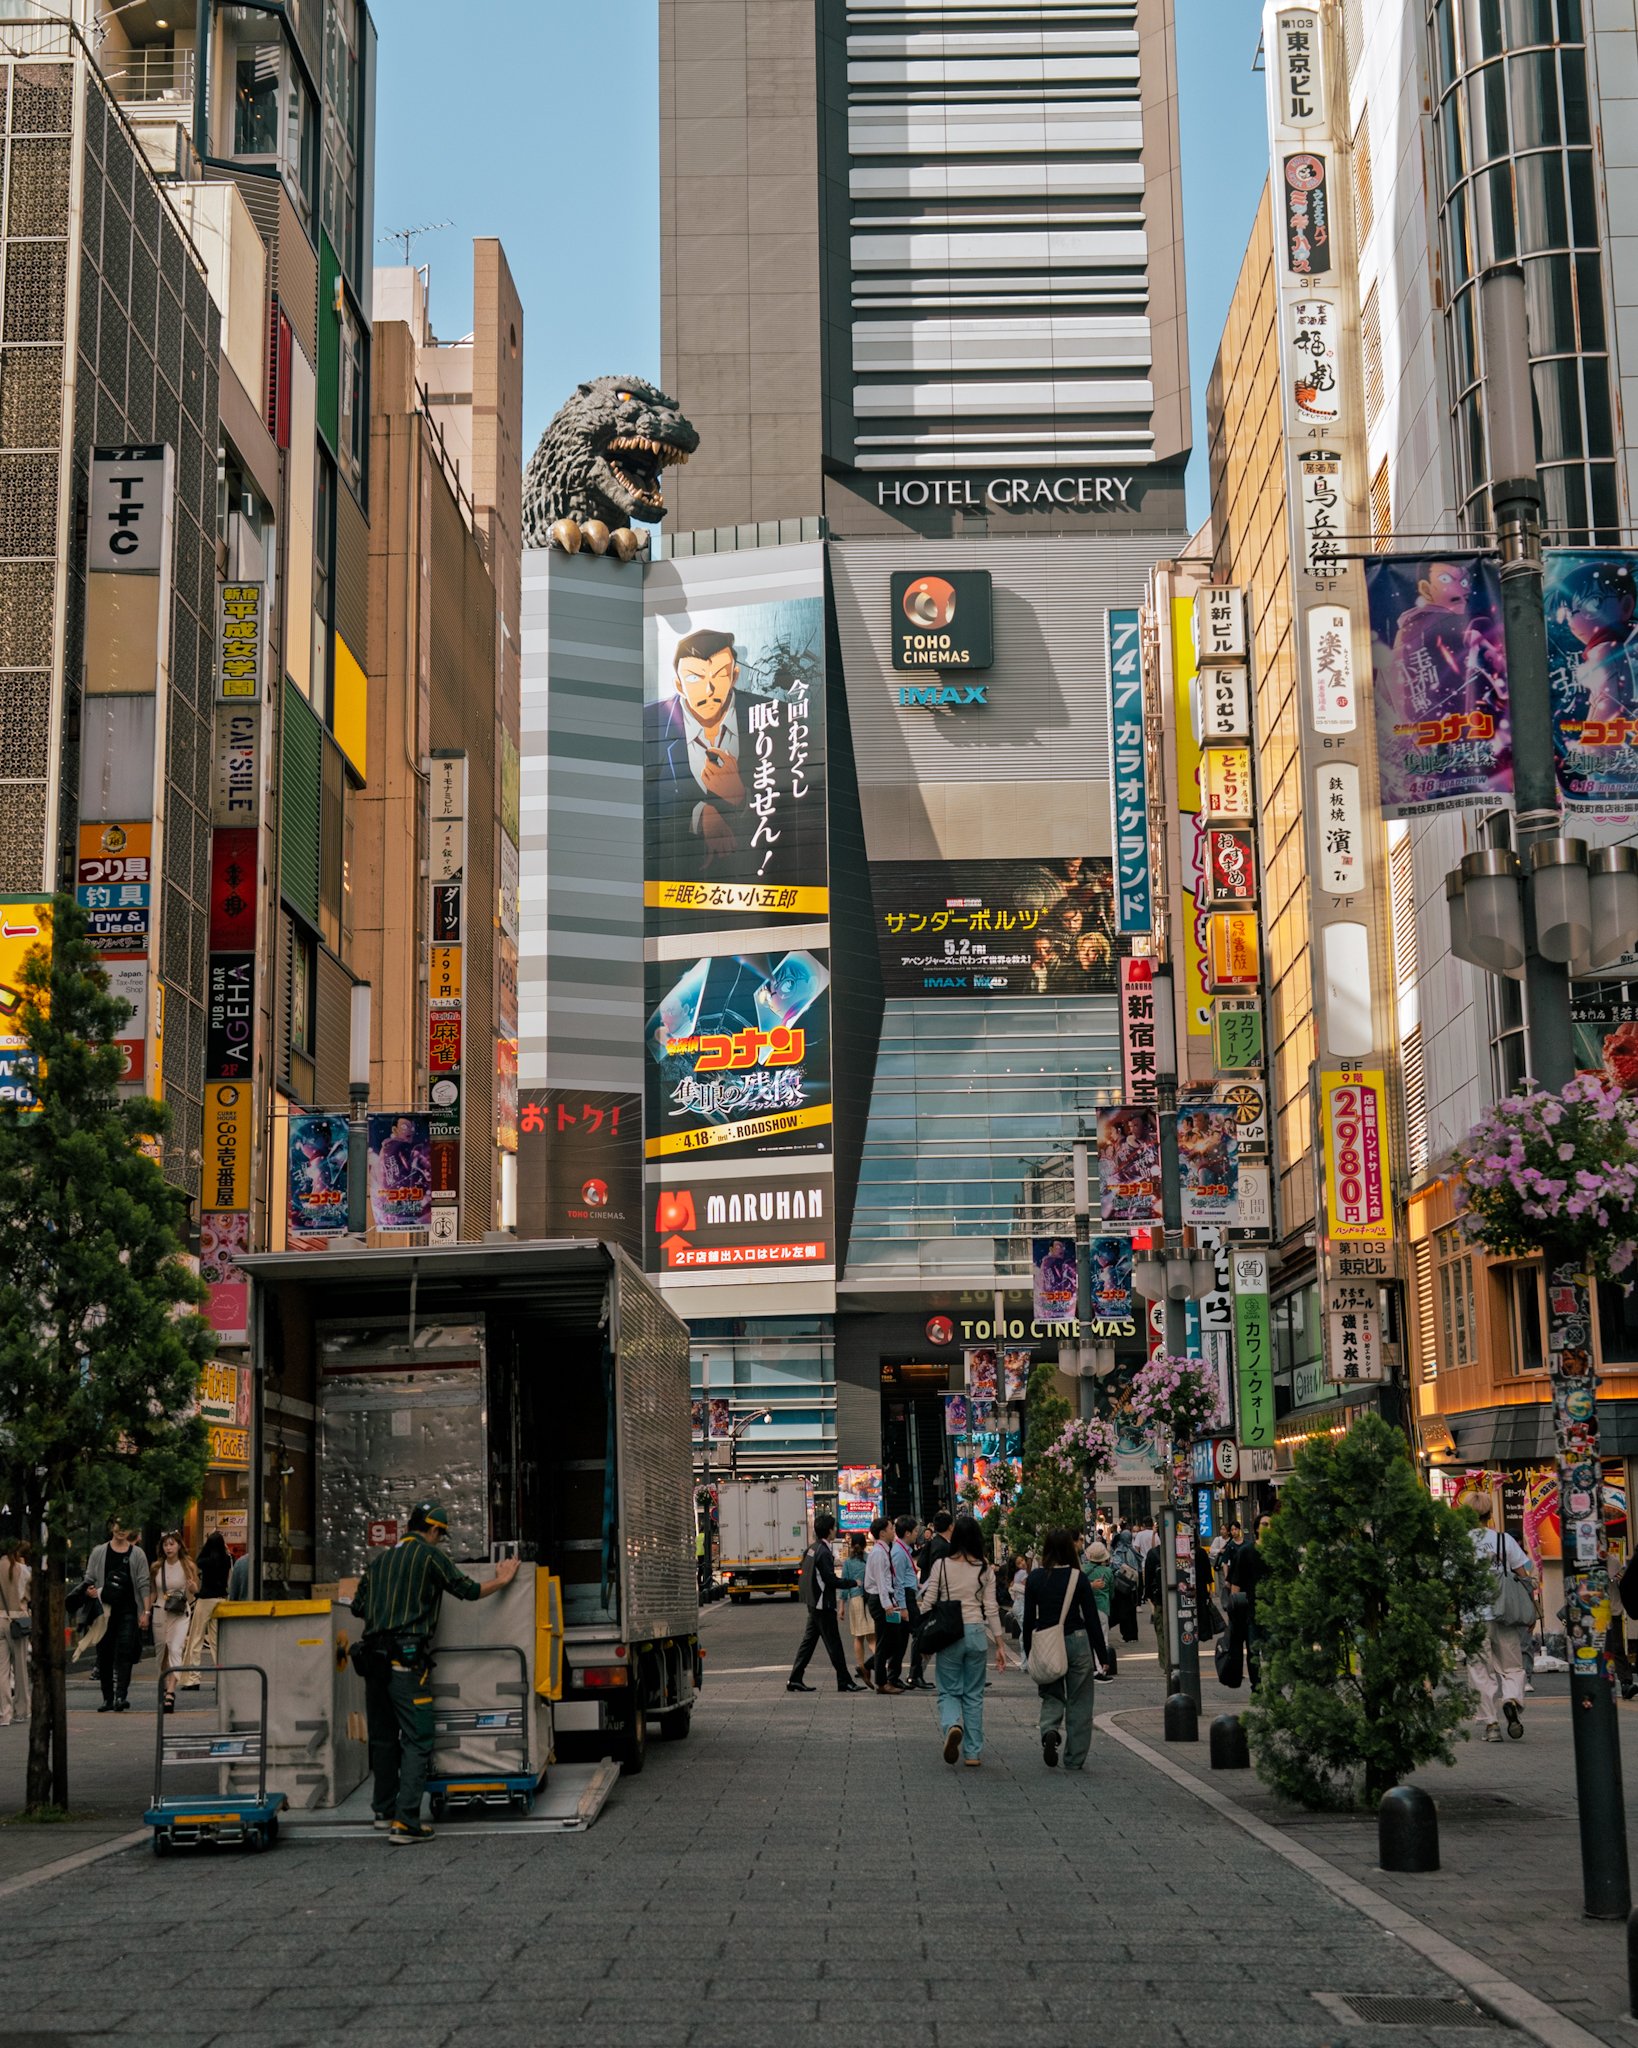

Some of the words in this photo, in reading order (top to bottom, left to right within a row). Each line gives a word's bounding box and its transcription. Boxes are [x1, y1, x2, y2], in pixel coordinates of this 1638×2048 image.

[1281, 19, 1313, 28] 第103
[1286, 31, 1314, 118] 東京ビル
[1299, 278, 1321, 288] 3F
[1308, 428, 1329, 438] 4F
[112, 450, 145, 461] 7F
[1310, 451, 1331, 460] 5F
[878, 480, 980, 505] HOTEL
[987, 477, 1134, 503] GRACERY
[108, 477, 145, 555] TFC
[223, 587, 259, 601] 新宿
[1315, 581, 1337, 591] 5F
[1210, 590, 1233, 653] 川新ビル
[223, 602, 258, 697] 平成女学園
[903, 634, 951, 649] TOHO
[903, 650, 970, 664] CINEMAS
[1112, 623, 1140, 708] 747
[1317, 631, 1346, 688] 楽天屋
[899, 686, 988, 705] IMAX
[1215, 669, 1235, 732] にいむら
[787, 679, 809, 798] 今回わたくし
[1323, 738, 1345, 748] 6F
[228, 717, 254, 811] CAPSULE
[443, 762, 453, 814] 第1モナミビル
[748, 698, 781, 876] 眠りません！
[1221, 755, 1239, 812] ととりこ
[1409, 780, 1435, 793] 4.18
[1438, 776, 1488, 788] ROADSHOW
[1329, 777, 1346, 822] 鉄板焼
[1397, 796, 1503, 817] 歌舞伎町商店街振興組合
[1115, 721, 1147, 920] カラオケランド
[1326, 828, 1351, 854] 濱
[1218, 833, 1245, 886] おすすめ
[80, 858, 149, 882] つり具
[86, 885, 144, 907] 釣具
[664, 884, 799, 909] #眠らない小五郎
[1216, 887, 1228, 898] 7F
[1332, 897, 1354, 908] 7F
[127, 911, 141, 921] &
[443, 886, 459, 930] ダーツ
[96, 921, 145, 934] Used
[944, 938, 970, 956] 5.2
[971, 945, 987, 955] FRI
[116, 978, 143, 987] Tax-free
[118, 970, 144, 979] Japan.
[213, 967, 225, 991] BAR
[440, 948, 451, 997] 299円
[923, 976, 968, 988] IMAX
[125, 986, 144, 995] Shop
[1221, 1000, 1256, 1010] 質・買取
[212, 1004, 225, 1029] PUB
[430, 1022, 460, 1065] 麻雀
[1224, 1019, 1239, 1066] クォーク
[221, 1064, 239, 1076] 2F
[1250, 1059, 1261, 1067] 5F
[1340, 1061, 1363, 1071] 8F
[1341, 1072, 1363, 1083] 9階
[668, 1070, 811, 1116] 隻眼の残像
[520, 1102, 620, 1135] おトク!
[429, 1126, 460, 1135] more
[684, 1130, 709, 1148] 4.18
[736, 1115, 798, 1138] ROADSHOW
[1246, 1126, 1264, 1138] UP
[1363, 1094, 1381, 1218] 店舗型ハンドサービス店
[567, 1210, 589, 1219] TOHO
[707, 1189, 823, 1225] MARUHAN
[1243, 1228, 1256, 1239] 3F
[675, 1245, 817, 1265] 2F店舗出入口はビル左側
[1339, 1242, 1386, 1255] 第103
[1339, 1258, 1387, 1275] 東京ビル
[1240, 1278, 1262, 1287] 買取
[1332, 1298, 1374, 1310] ルノアール
[1341, 1314, 1360, 1379] 磯丸水産
[1246, 1321, 1265, 1441] カワノ・クォーク
[1198, 1490, 1209, 1536] カラオケ
